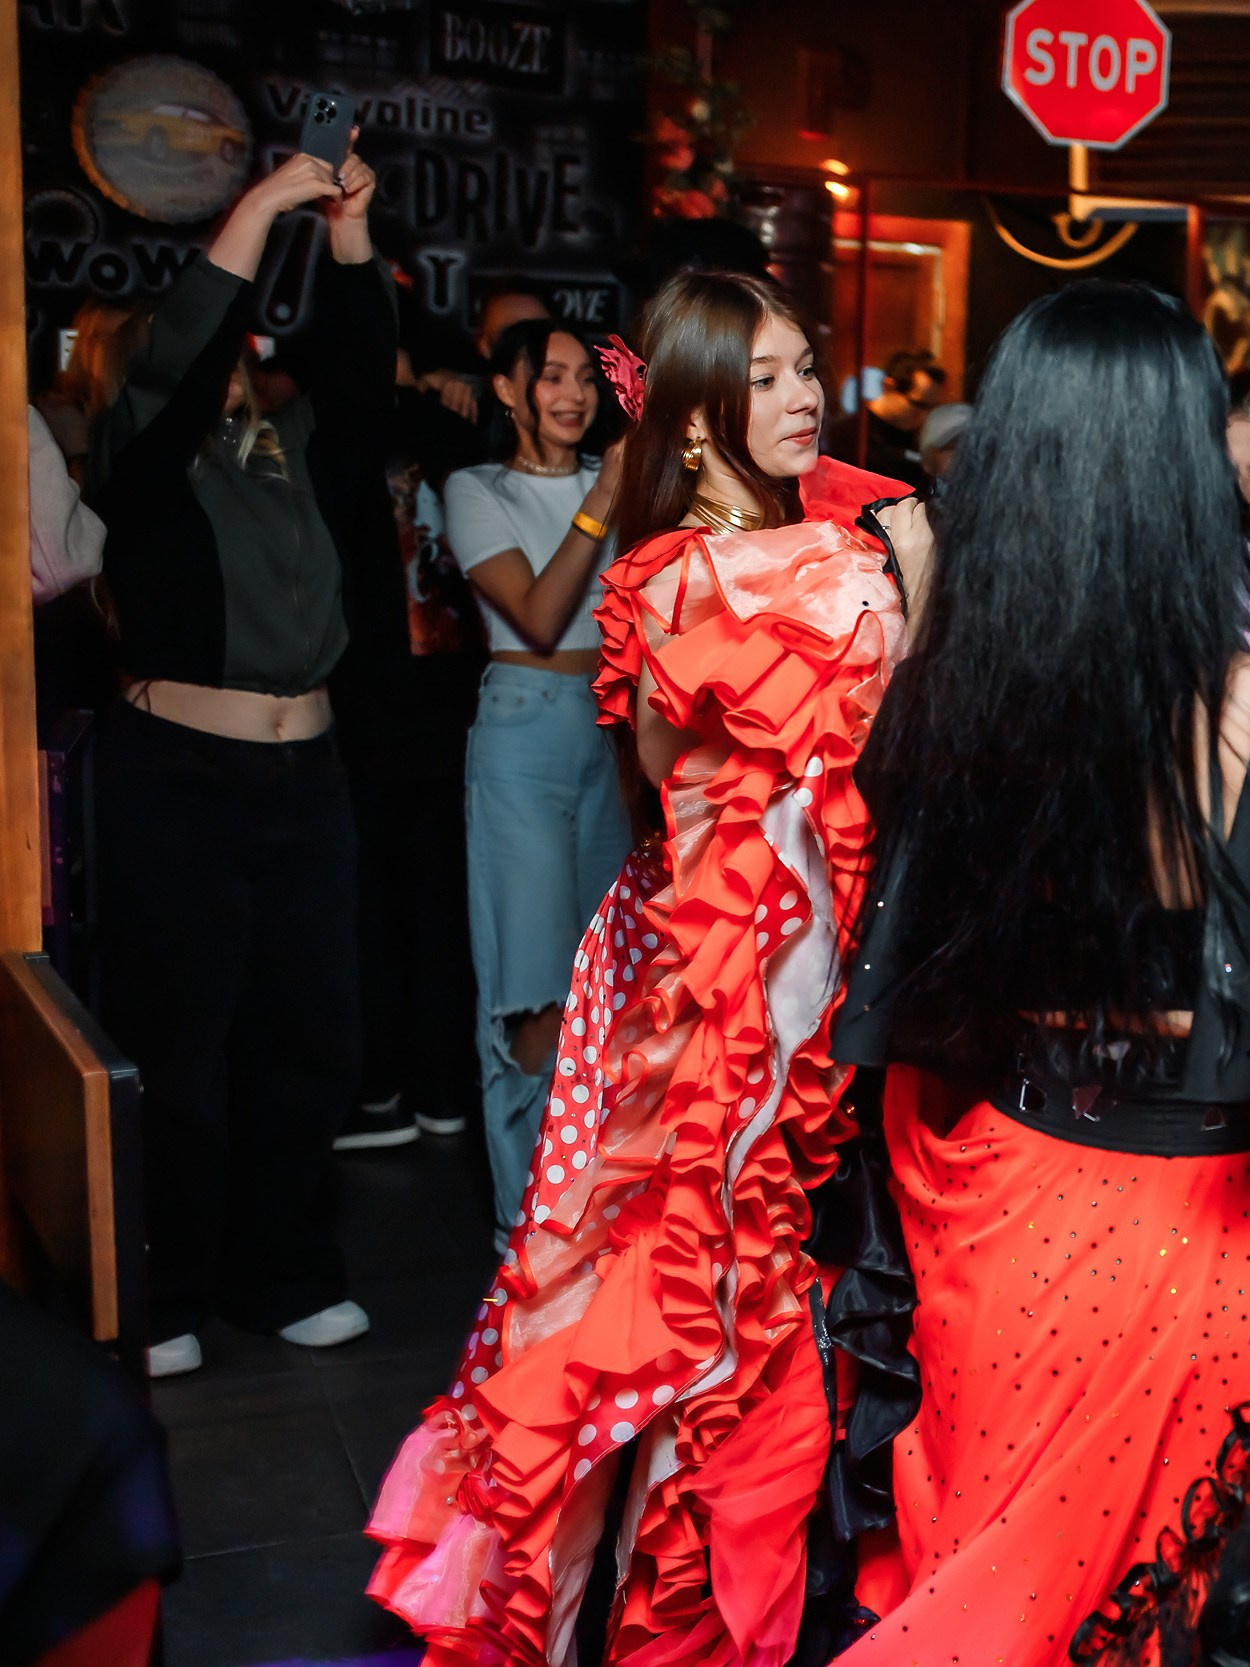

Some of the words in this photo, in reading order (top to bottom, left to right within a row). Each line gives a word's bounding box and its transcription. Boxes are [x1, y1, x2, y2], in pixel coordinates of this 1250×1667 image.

[442, 11, 551, 74] BOOZE
[1023, 27, 1158, 95] STOP
[266, 83, 489, 134] Vvoline
[415, 149, 582, 247] DRIVE
